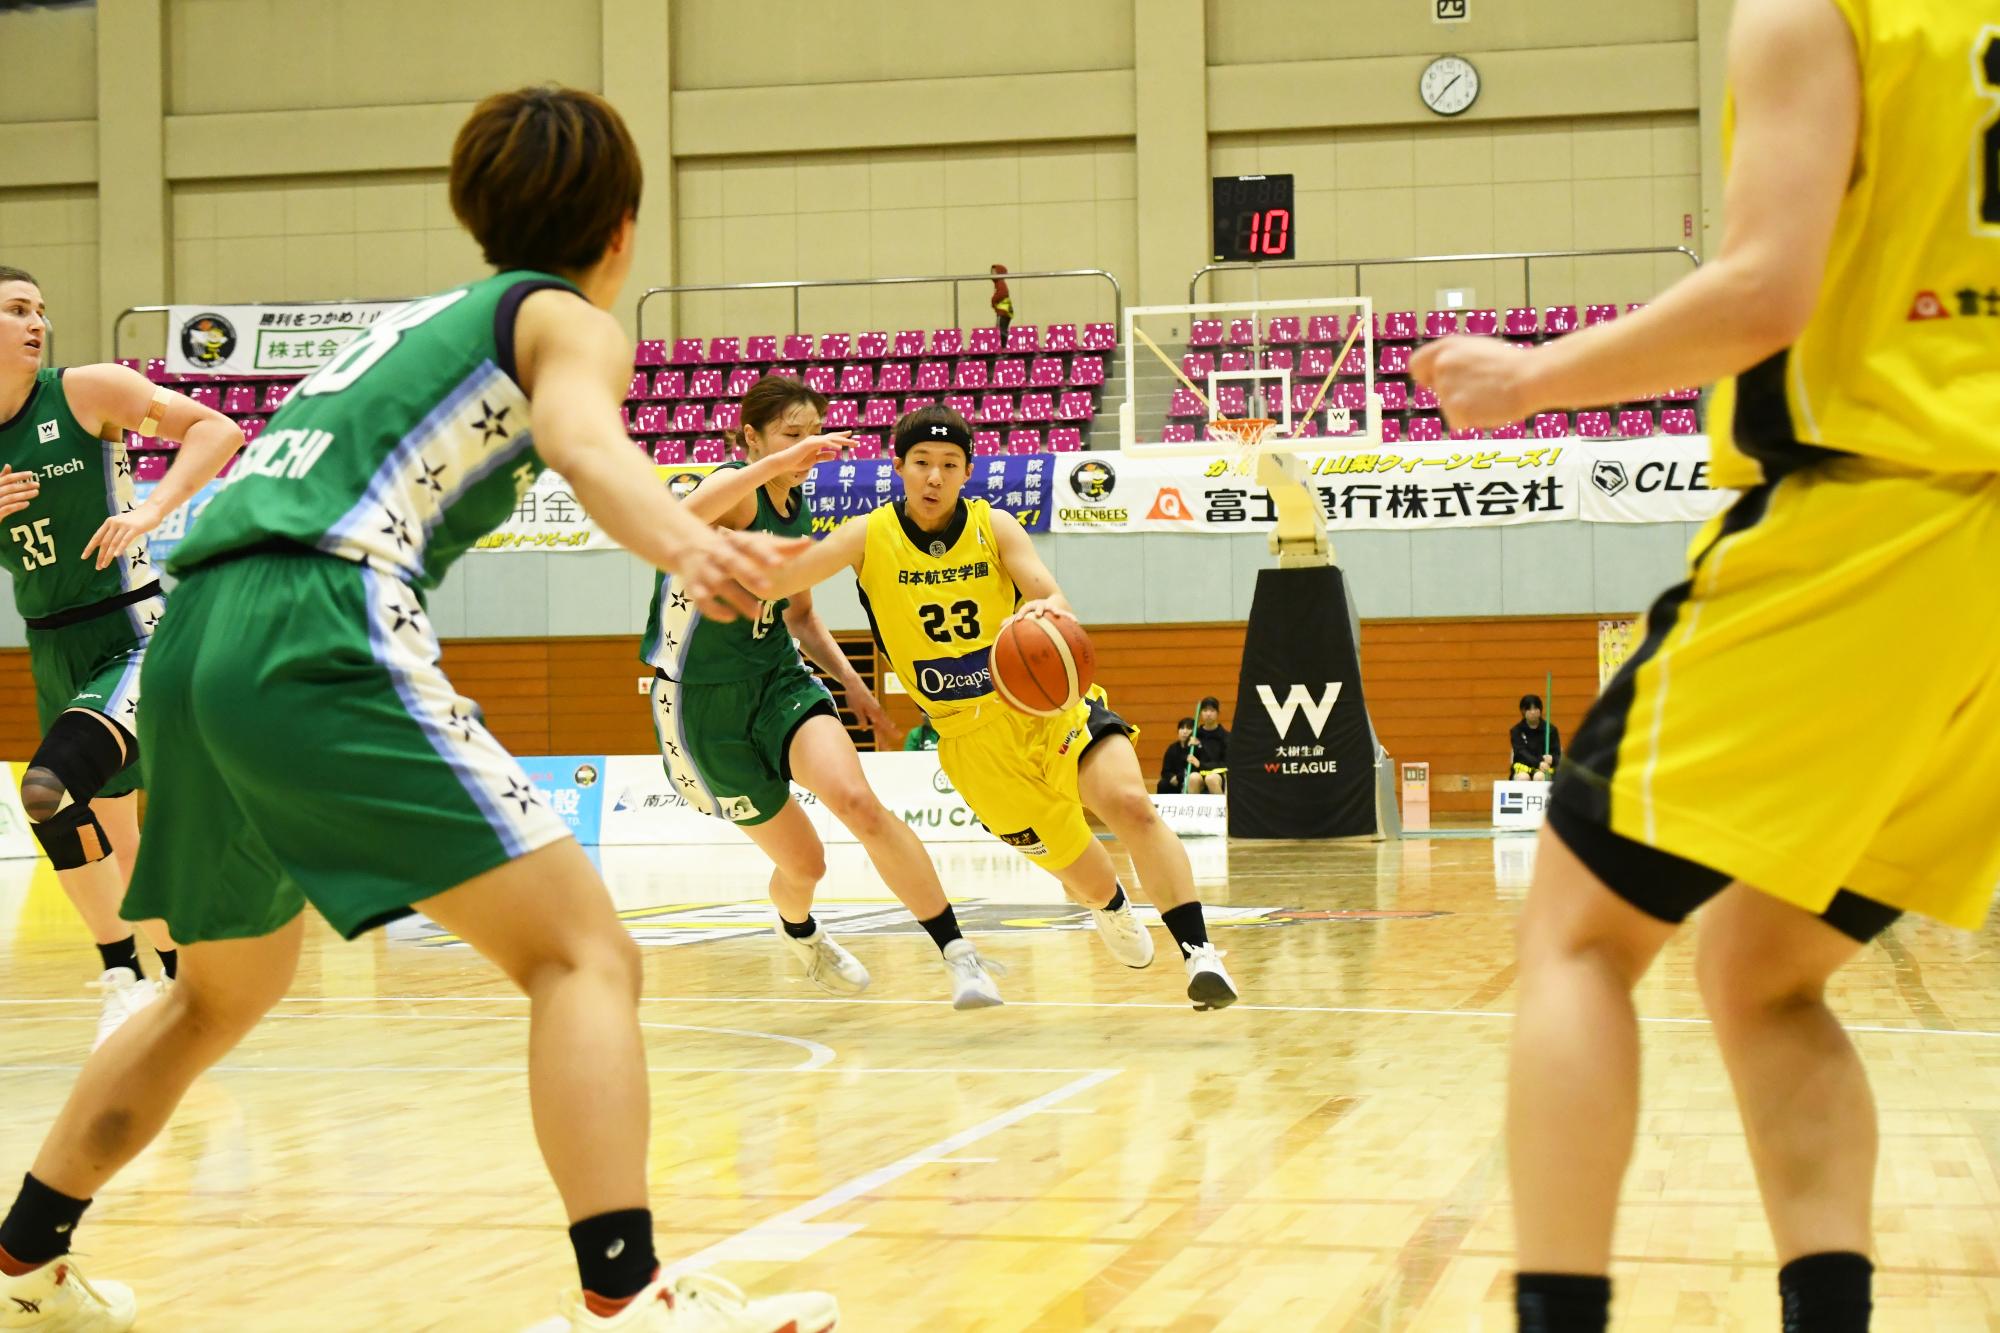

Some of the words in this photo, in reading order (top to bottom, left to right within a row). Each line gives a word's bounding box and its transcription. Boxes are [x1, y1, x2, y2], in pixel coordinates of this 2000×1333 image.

[1250, 209, 1289, 254] 10
[267, 338, 342, 359] 株式会
[1635, 461, 1718, 492] CLE
[1059, 508, 1128, 521] QUEENBEES
[10, 517, 57, 571] 35
[898, 561, 989, 585] 日本航空学園
[918, 599, 981, 643] 23
[920, 666, 992, 694] O2caps
[1255, 682, 1343, 741] W
[1275, 744, 1326, 758] 大樹生命
[1264, 763, 1280, 774] W
[1281, 761, 1337, 775] LEAGUE
